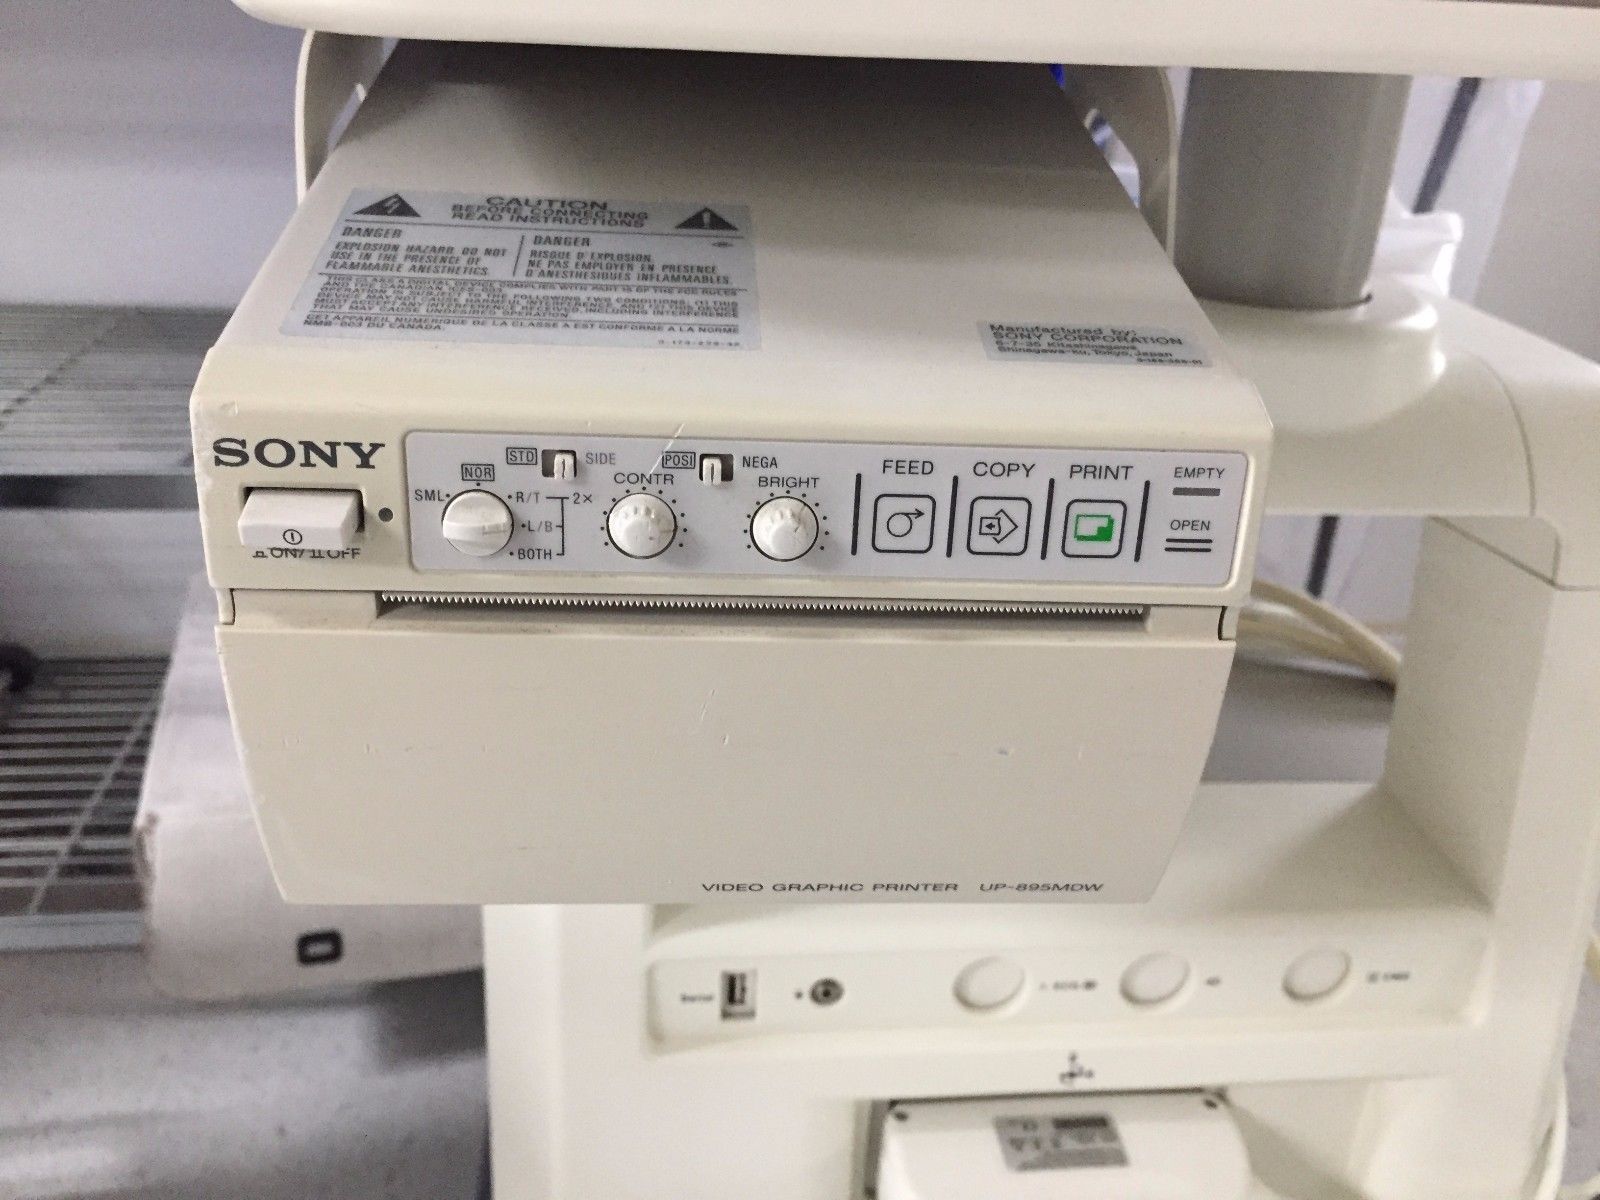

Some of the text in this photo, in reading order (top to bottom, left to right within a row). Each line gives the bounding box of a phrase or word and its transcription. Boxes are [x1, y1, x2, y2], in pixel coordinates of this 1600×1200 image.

[486, 196, 607, 210] CAUTION
[341, 226, 401, 238] DANGER
[533, 235, 590, 246] DANGER
[334, 241, 399, 252] EXPLOSION
[461, 247, 478, 255] DO
[483, 247, 506, 257] NOT
[330, 251, 353, 259] USE
[357, 252, 373, 260] IN
[403, 254, 460, 264] PRESENCE
[325, 260, 403, 272] FLAMMABLE
[527, 259, 542, 268] NE
[547, 260, 568, 269] PAS
[661, 264, 717, 274] PRESENCE
[989, 323, 1102, 335] Manufactured
[992, 331, 1184, 345] SONY CORPORATION
[212, 437, 385, 469] SONY
[509, 449, 534, 463] STD
[585, 452, 616, 465] SIDE
[664, 453, 694, 468] POSI
[742, 455, 778, 469] NEGA
[882, 459, 934, 475] FEED
[463, 465, 493, 480] NOR
[972, 461, 1036, 478] COPY
[1069, 464, 1134, 481] PRINT
[1173, 466, 1225, 480] EMPTY
[613, 472, 675, 486] CONTR
[758, 476, 820, 489] BRIGHT
[414, 489, 443, 502] SML
[515, 491, 540, 504] R/T
[527, 519, 553, 533] L/B
[1170, 518, 1211, 532] OPEN
[517, 547, 552, 560] BOTH
[702, 883, 1105, 892] VIDEO GRAPHIC PRINTER UP-895MDW
